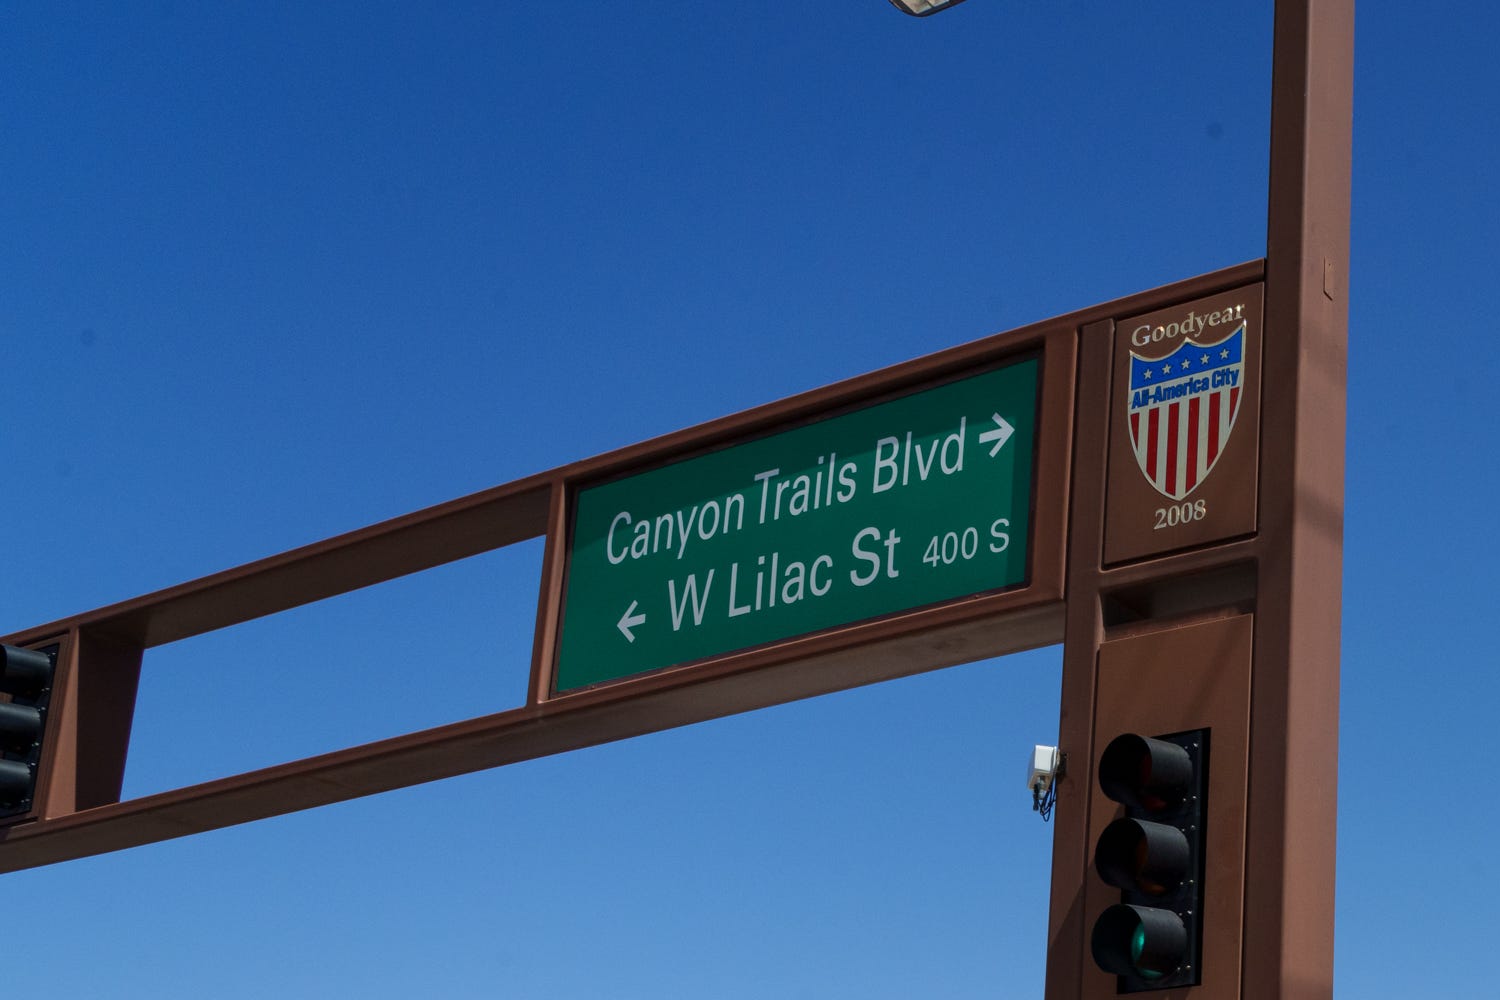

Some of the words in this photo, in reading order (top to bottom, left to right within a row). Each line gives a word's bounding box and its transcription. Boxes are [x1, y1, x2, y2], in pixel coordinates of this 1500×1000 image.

[1131, 304, 1245, 347] Goodyear
[1131, 376, 1209, 410] All-America
[1211, 368, 1240, 389] City
[606, 489, 744, 565] Canyon
[754, 454, 856, 525] Trails
[872, 415, 967, 494] Blvd
[1153, 499, 1207, 530] 2008
[667, 568, 715, 632] W
[728, 551, 833, 619] Lilac
[849, 525, 901, 587] St
[922, 526, 979, 567] 400
[989, 518, 1010, 553] S
